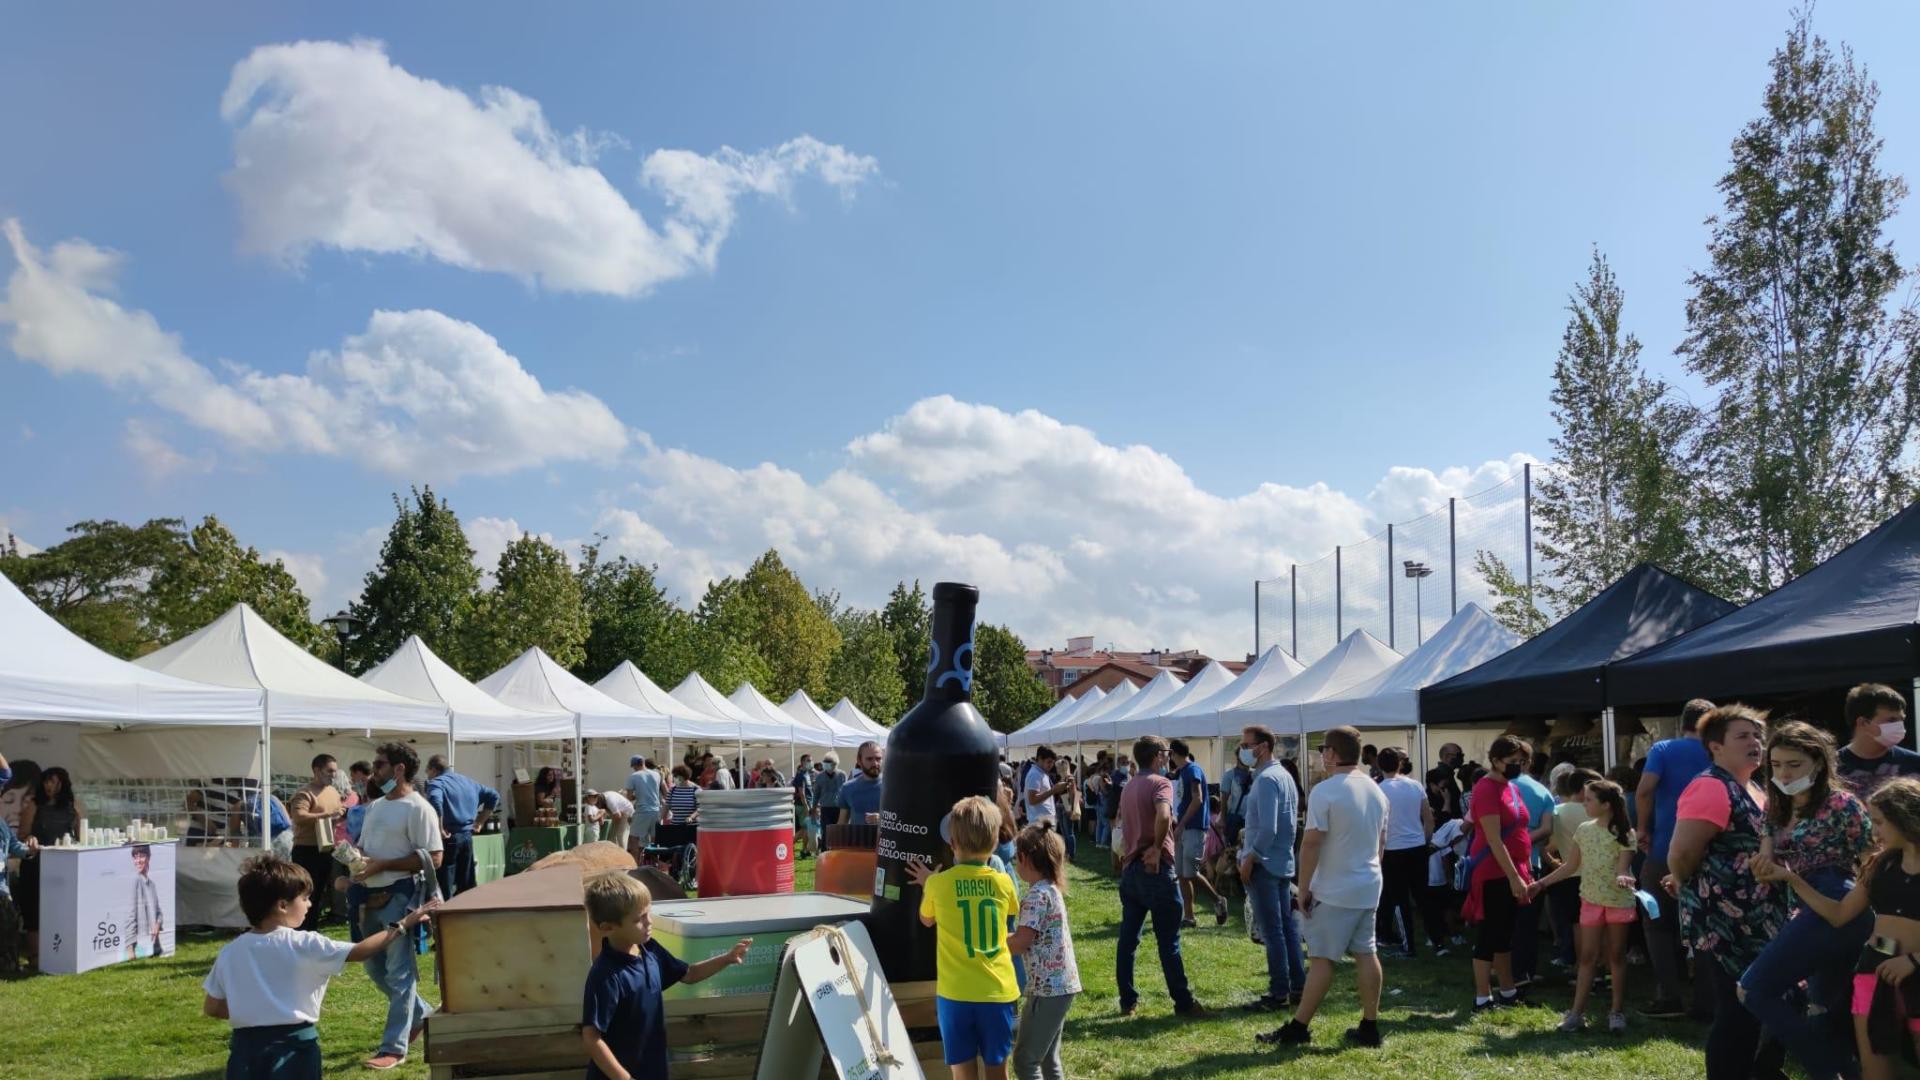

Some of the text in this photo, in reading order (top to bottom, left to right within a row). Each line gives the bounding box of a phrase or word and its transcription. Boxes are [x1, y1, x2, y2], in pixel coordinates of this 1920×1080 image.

[880, 820, 928, 835] ECOLÓGICO
[956, 879, 996, 897] BRASIL
[97, 922, 117, 937] So
[957, 898, 1000, 959] 10
[92, 935, 120, 951] free
